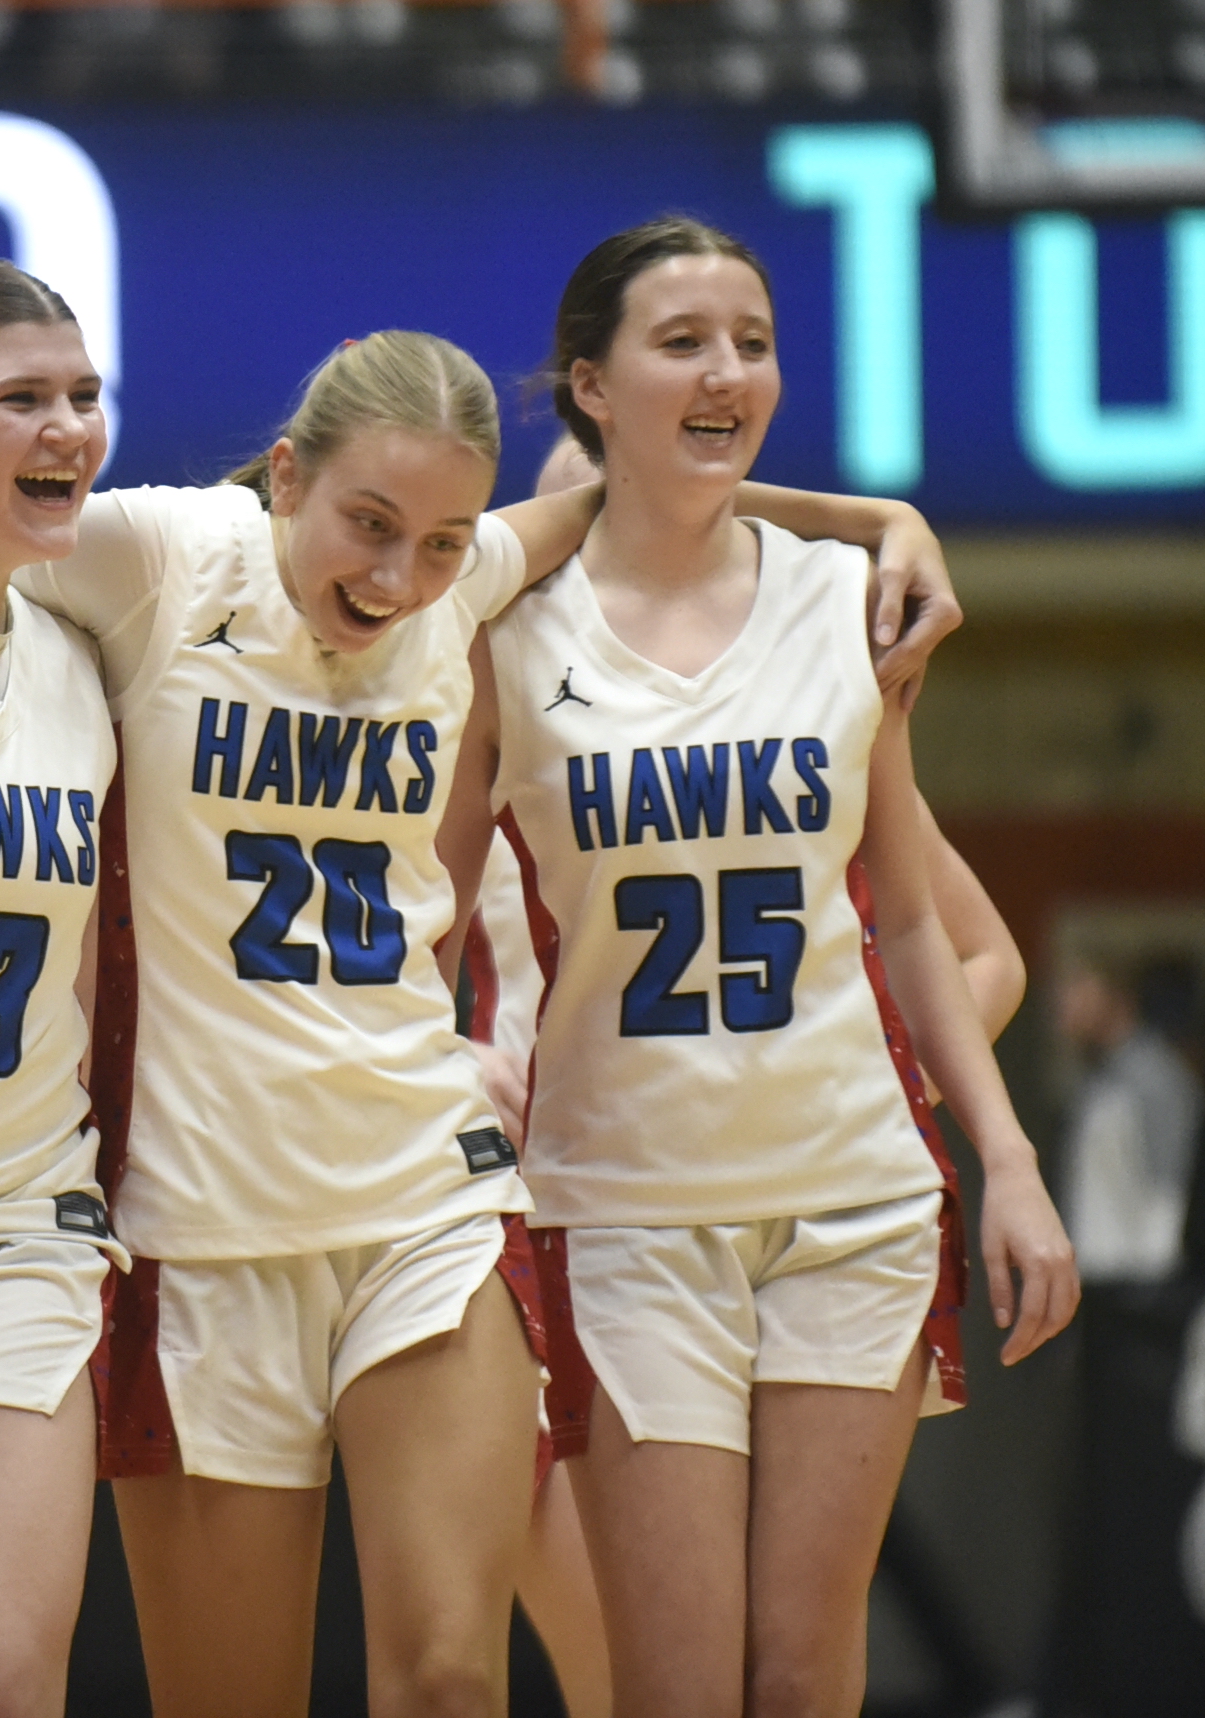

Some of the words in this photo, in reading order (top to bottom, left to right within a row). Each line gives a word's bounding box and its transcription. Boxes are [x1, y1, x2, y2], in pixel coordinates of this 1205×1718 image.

[193, 697, 438, 814] HAWKS
[567, 737, 831, 851] HAWKS
[225, 829, 406, 985] 20
[614, 866, 806, 1038] 25
